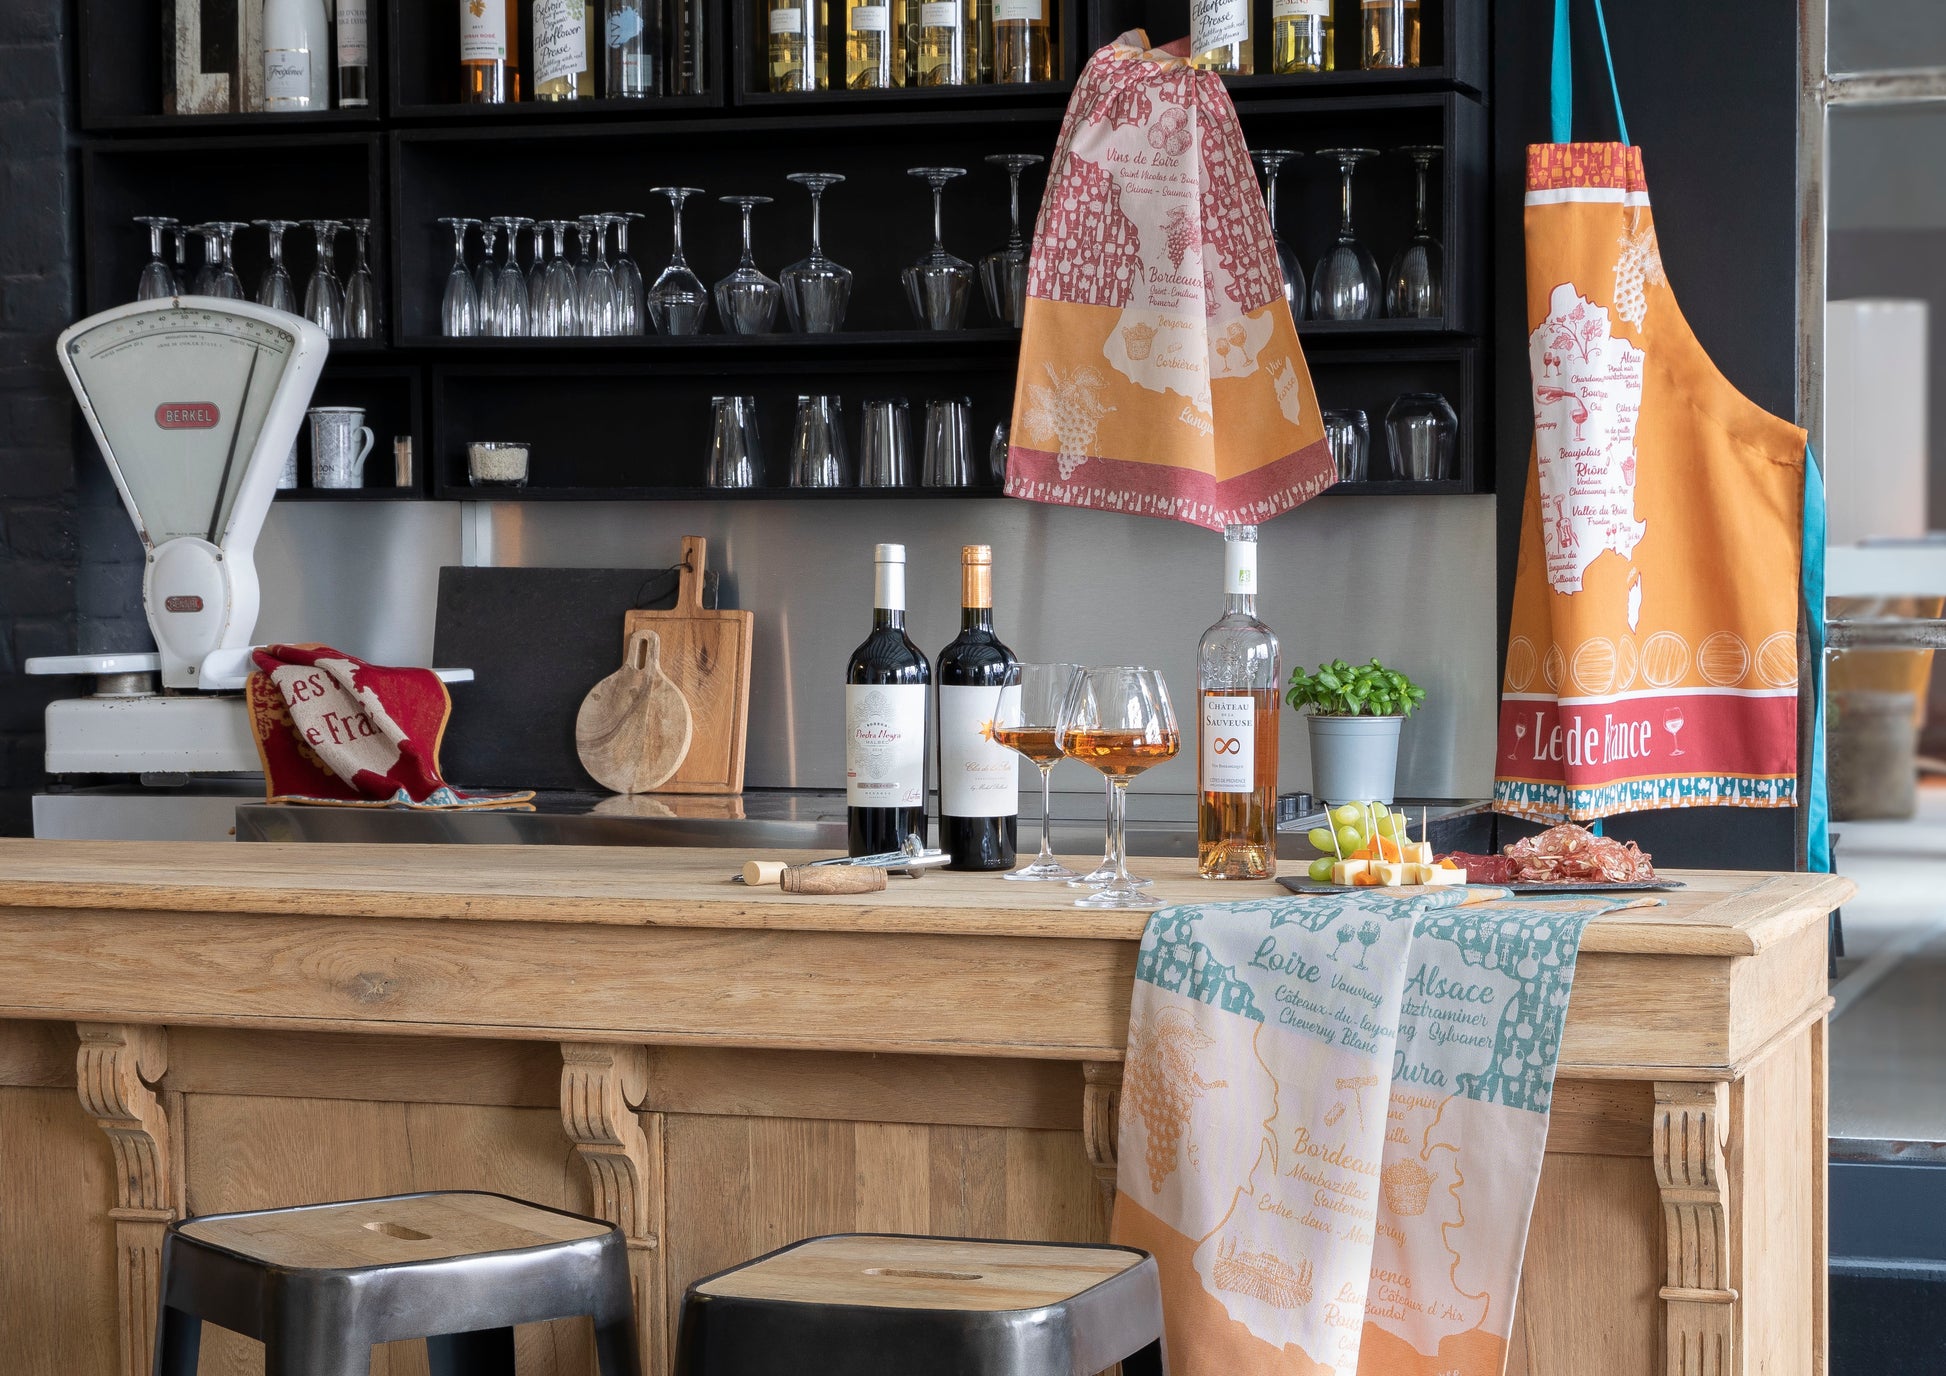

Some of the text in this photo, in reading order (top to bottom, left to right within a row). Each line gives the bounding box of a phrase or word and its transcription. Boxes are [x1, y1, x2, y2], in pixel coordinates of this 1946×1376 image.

[1106, 148, 1179, 167] Vins de Loire
[1168, 174, 1177, 182] de
[1149, 266, 1204, 289] Bordeaux
[1148, 296, 1179, 308] Pomerol
[166, 409, 212, 422] BERKEL
[1559, 446, 1600, 460] Beaujolais
[1574, 462, 1608, 477] Rhône
[1572, 506, 1598, 516] Vallée
[322, 711, 384, 745] Fra
[1206, 715, 1252, 726] SAUVEUSE
[1566, 716, 1599, 766] de
[1248, 935, 1383, 1009] Loire Vouvray
[1403, 962, 1495, 1004] Alsace
[1279, 1006, 1378, 1054] Cheverny Blanc
[1428, 1022, 1494, 1048] Sylvaner
[1293, 1127, 1380, 1178] Bordeau
